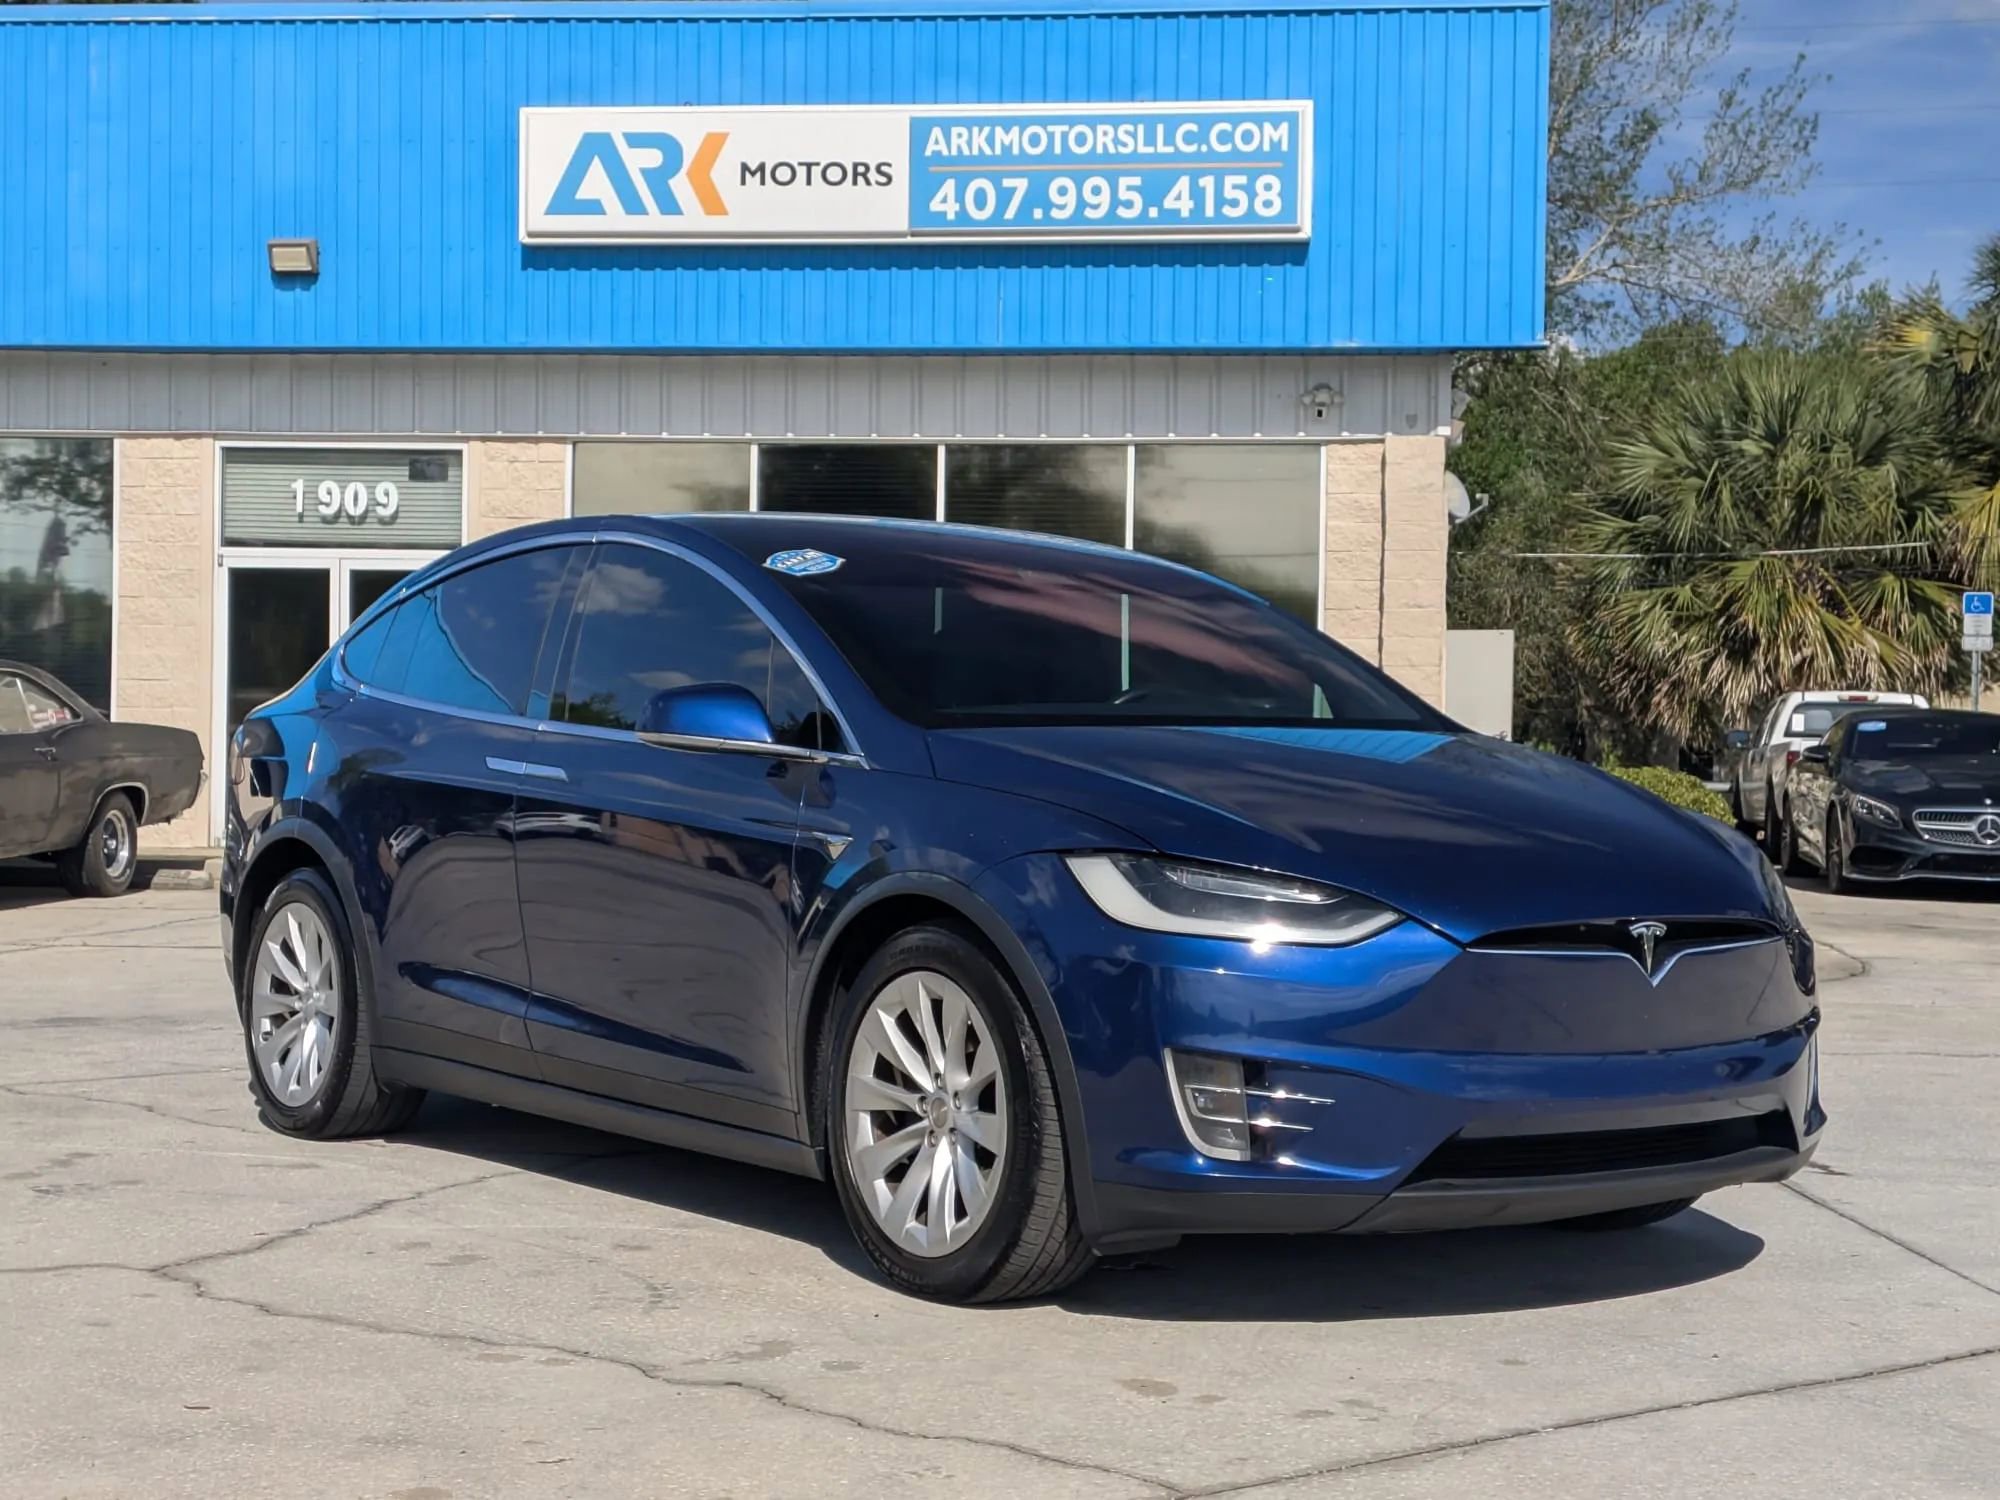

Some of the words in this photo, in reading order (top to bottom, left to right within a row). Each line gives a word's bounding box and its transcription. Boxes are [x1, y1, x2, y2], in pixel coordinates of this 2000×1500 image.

[925, 122, 1289, 156] ARKMOTORSLLC.COM
[544, 132, 728, 216] ARK
[740, 161, 893, 188] MOTORS
[930, 174, 1282, 220] 407.995.4158
[291, 478, 399, 516] 1909
